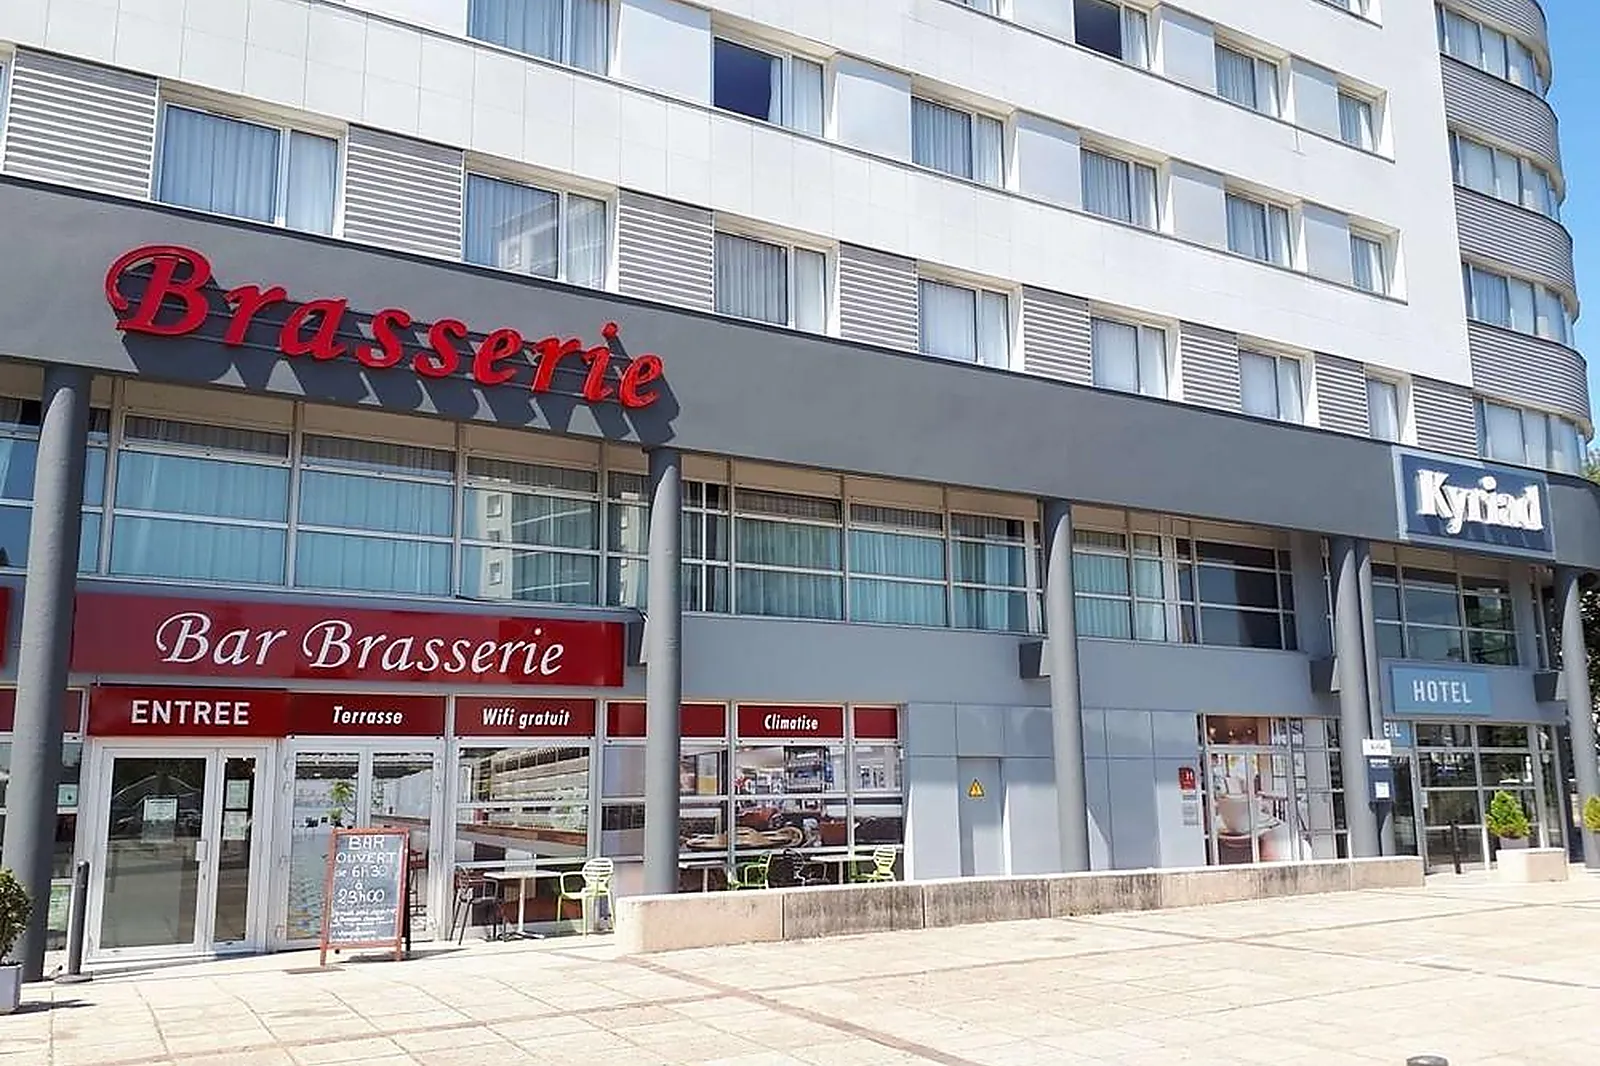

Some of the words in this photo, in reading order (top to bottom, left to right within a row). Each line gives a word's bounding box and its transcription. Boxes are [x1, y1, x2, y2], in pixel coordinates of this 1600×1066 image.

[105, 244, 664, 409] Brasserie
[1416, 468, 1544, 535] Kyriad
[155, 612, 288, 666] Bar
[301, 619, 565, 676] Brasserie
[1412, 680, 1472, 703] HOTEL
[131, 700, 250, 726] ENTREE
[332, 705, 403, 726] Terrasse
[482, 708, 514, 727] Wifi
[518, 709, 570, 730] gratuit
[764, 714, 818, 731] Climatise
[1384, 722, 1401, 737] EIL
[349, 835, 385, 850] BAR
[336, 852, 396, 865] OUVERT
